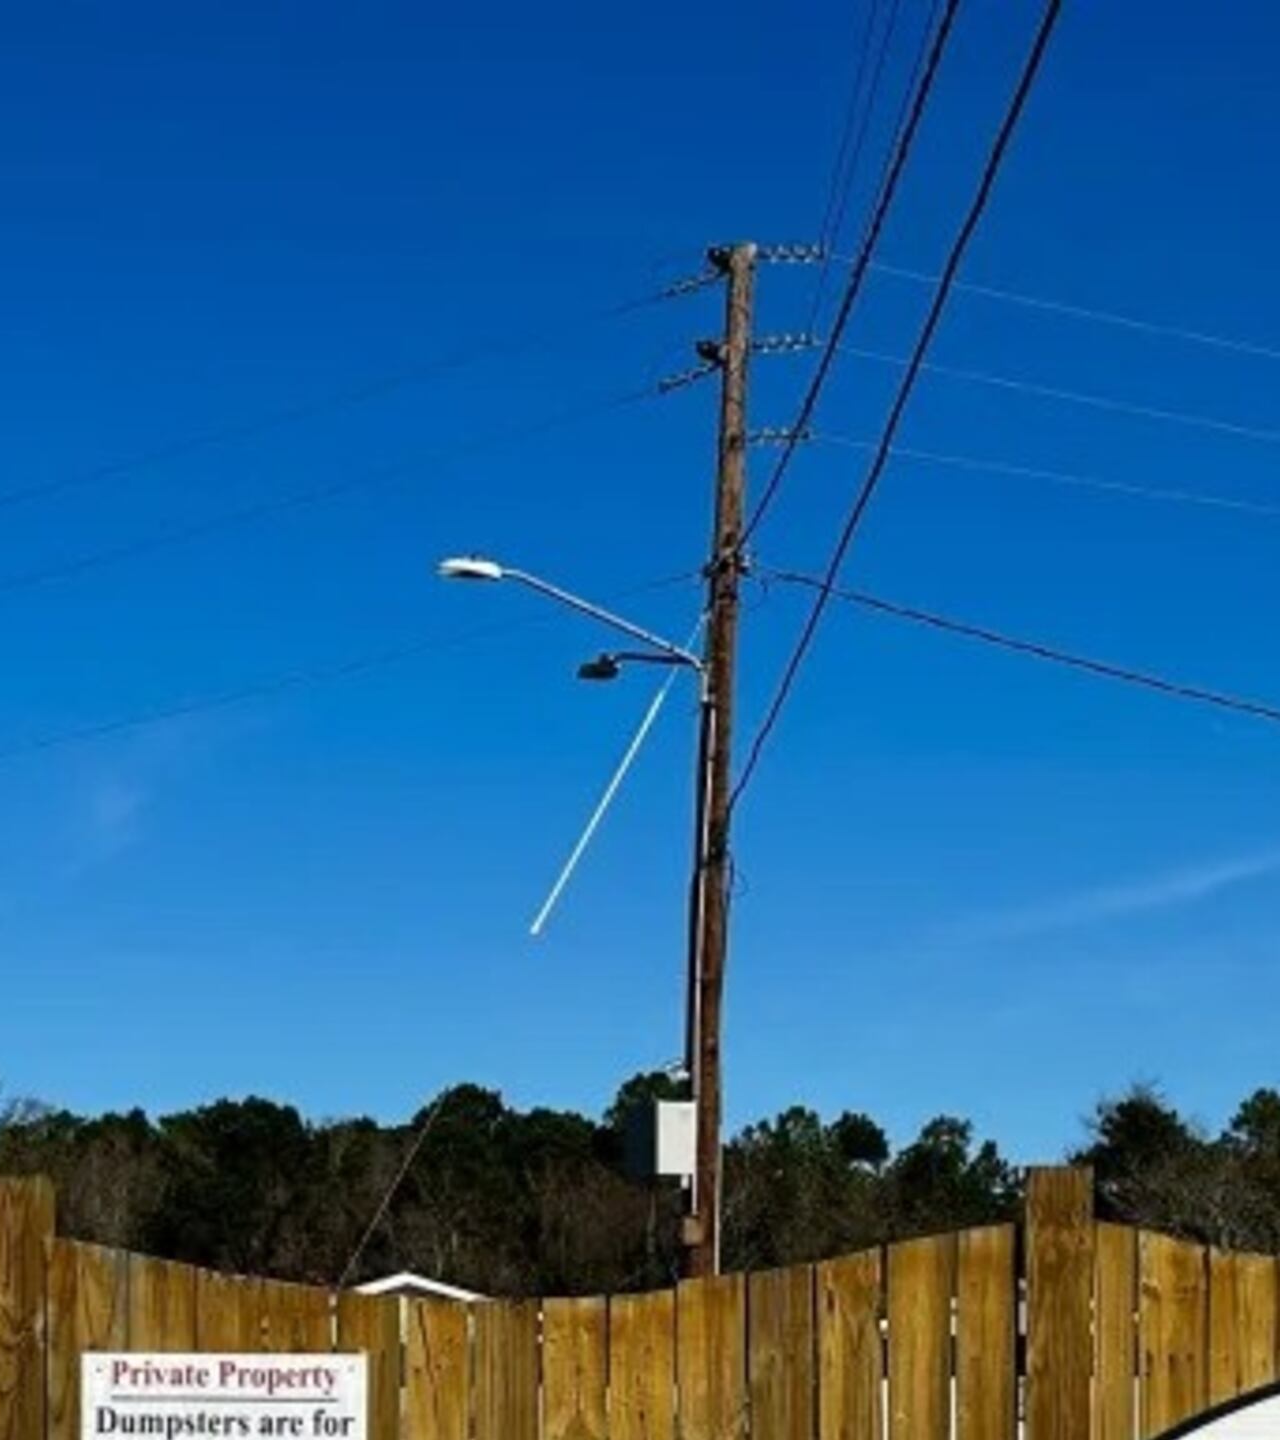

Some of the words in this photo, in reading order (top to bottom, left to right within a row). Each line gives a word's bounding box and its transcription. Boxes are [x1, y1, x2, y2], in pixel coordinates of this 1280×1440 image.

[111, 1361, 209, 1388] Private
[219, 1361, 337, 1396] Property
[96, 1408, 251, 1440] Dumpsters
[258, 1416, 303, 1435] are
[313, 1409, 355, 1436] for
